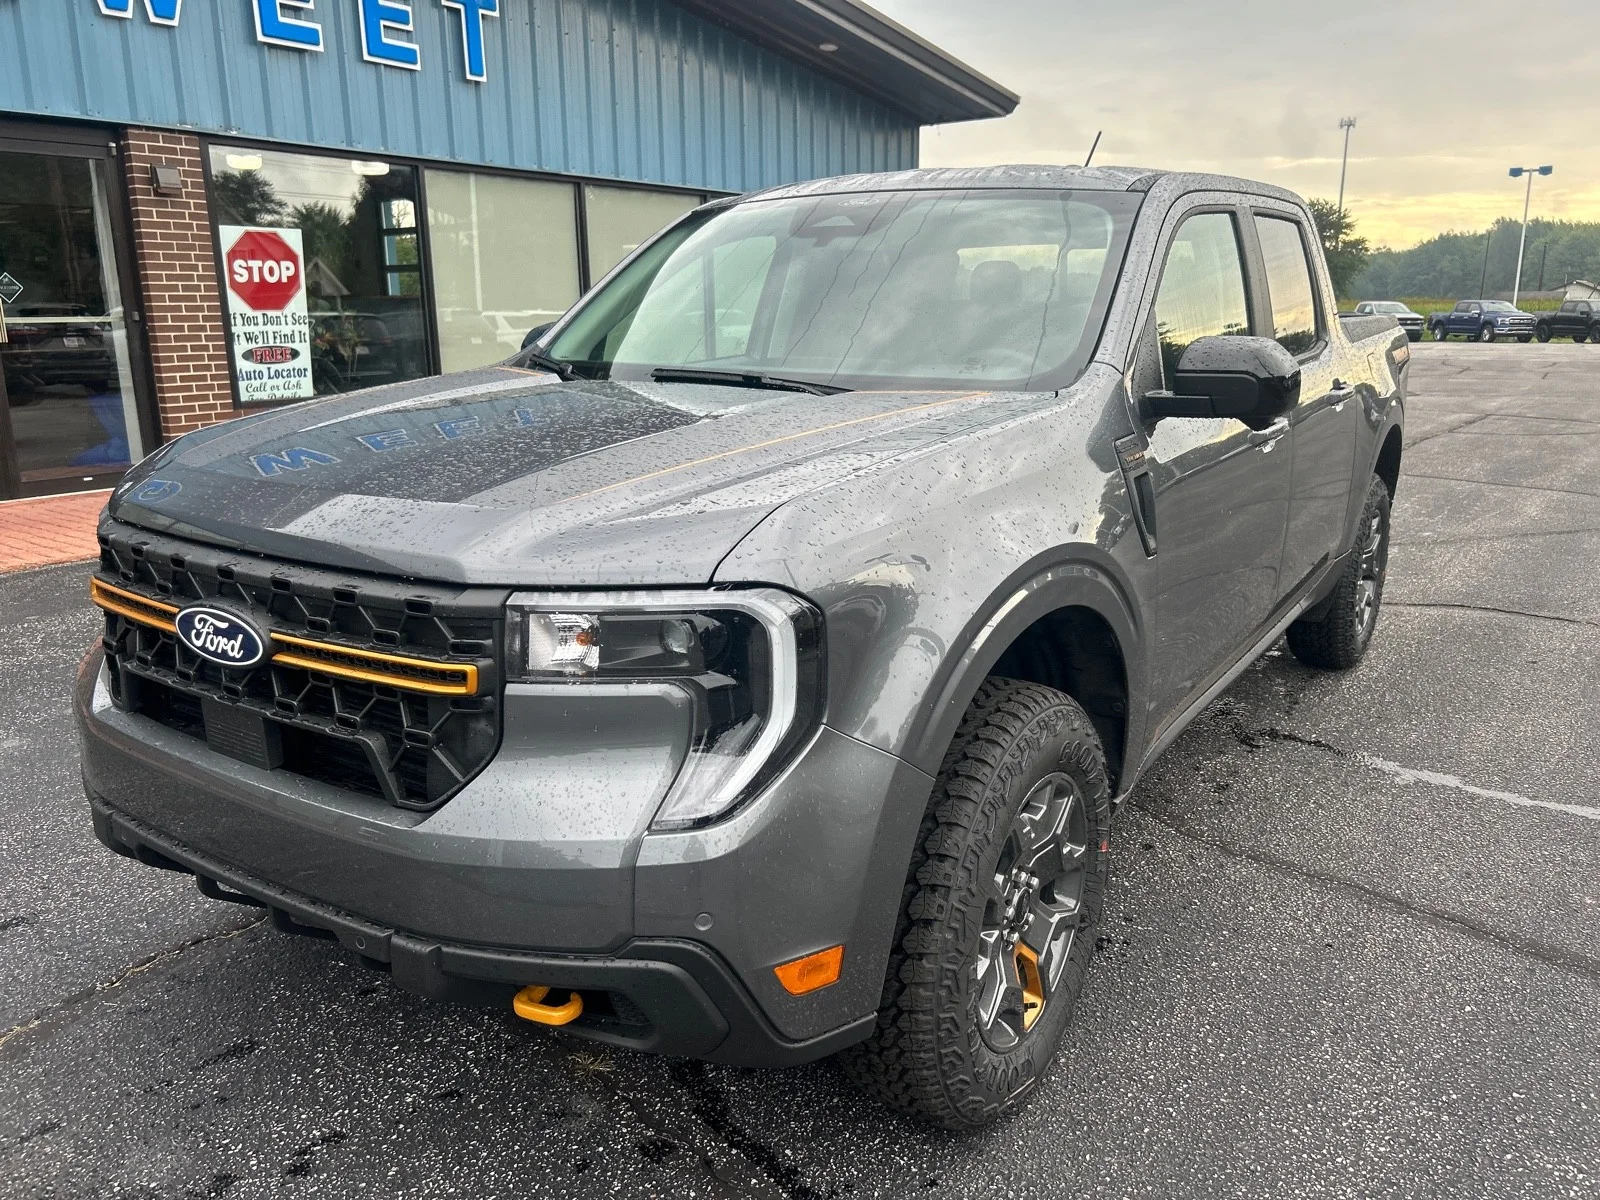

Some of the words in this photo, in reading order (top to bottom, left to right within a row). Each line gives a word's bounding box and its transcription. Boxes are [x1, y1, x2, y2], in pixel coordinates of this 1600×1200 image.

[98, 0, 500, 82] EET
[233, 259, 296, 284] STOP
[240, 313, 259, 327] You
[262, 312, 288, 326] Don't
[291, 312, 308, 326] See
[244, 331, 270, 345] We'll
[273, 330, 296, 344] Find
[298, 331, 307, 344] It
[252, 347, 292, 363] FREE
[238, 368, 264, 381] Auto
[267, 366, 308, 380] Locator
[245, 382, 267, 393] Call
[283, 380, 302, 391] Ask
[191, 614, 243, 658] Ford
